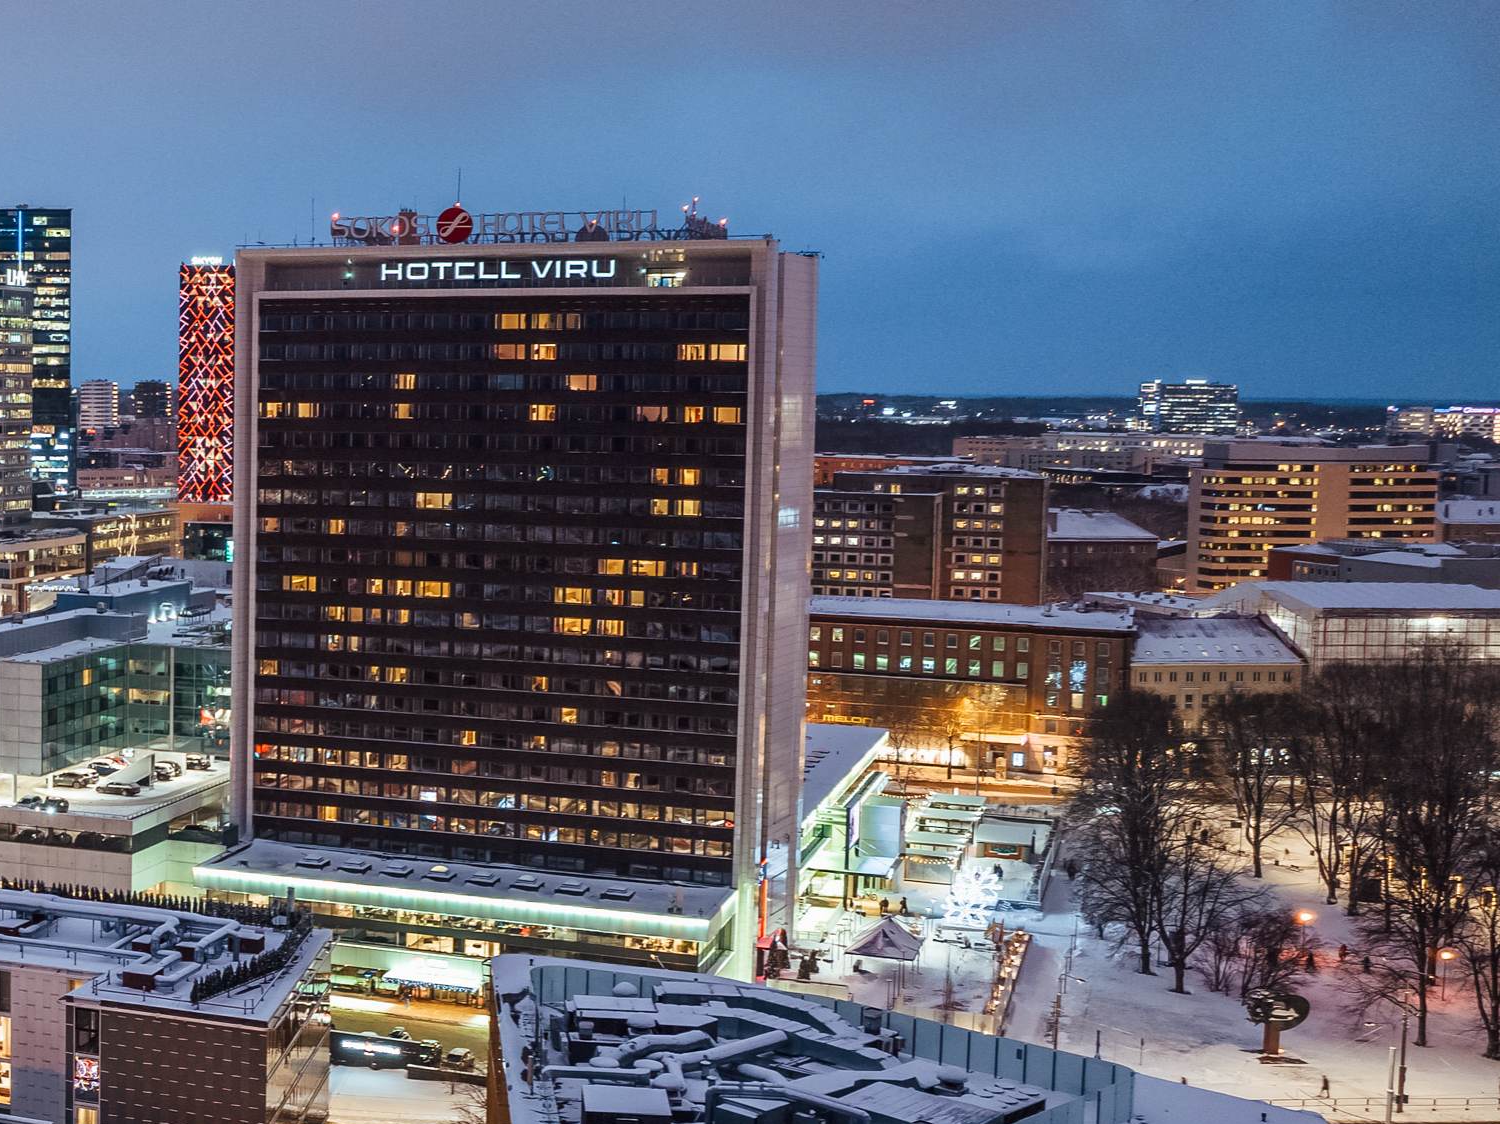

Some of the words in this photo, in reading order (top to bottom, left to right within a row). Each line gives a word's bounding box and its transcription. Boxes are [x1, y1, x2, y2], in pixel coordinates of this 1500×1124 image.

[331, 215, 428, 238] SOKOS
[479, 211, 565, 234] HOTEL
[580, 209, 658, 232] VIRU
[6, 269, 28, 287] LHV
[381, 261, 521, 281] HOTELL
[532, 260, 616, 278] VIRU
